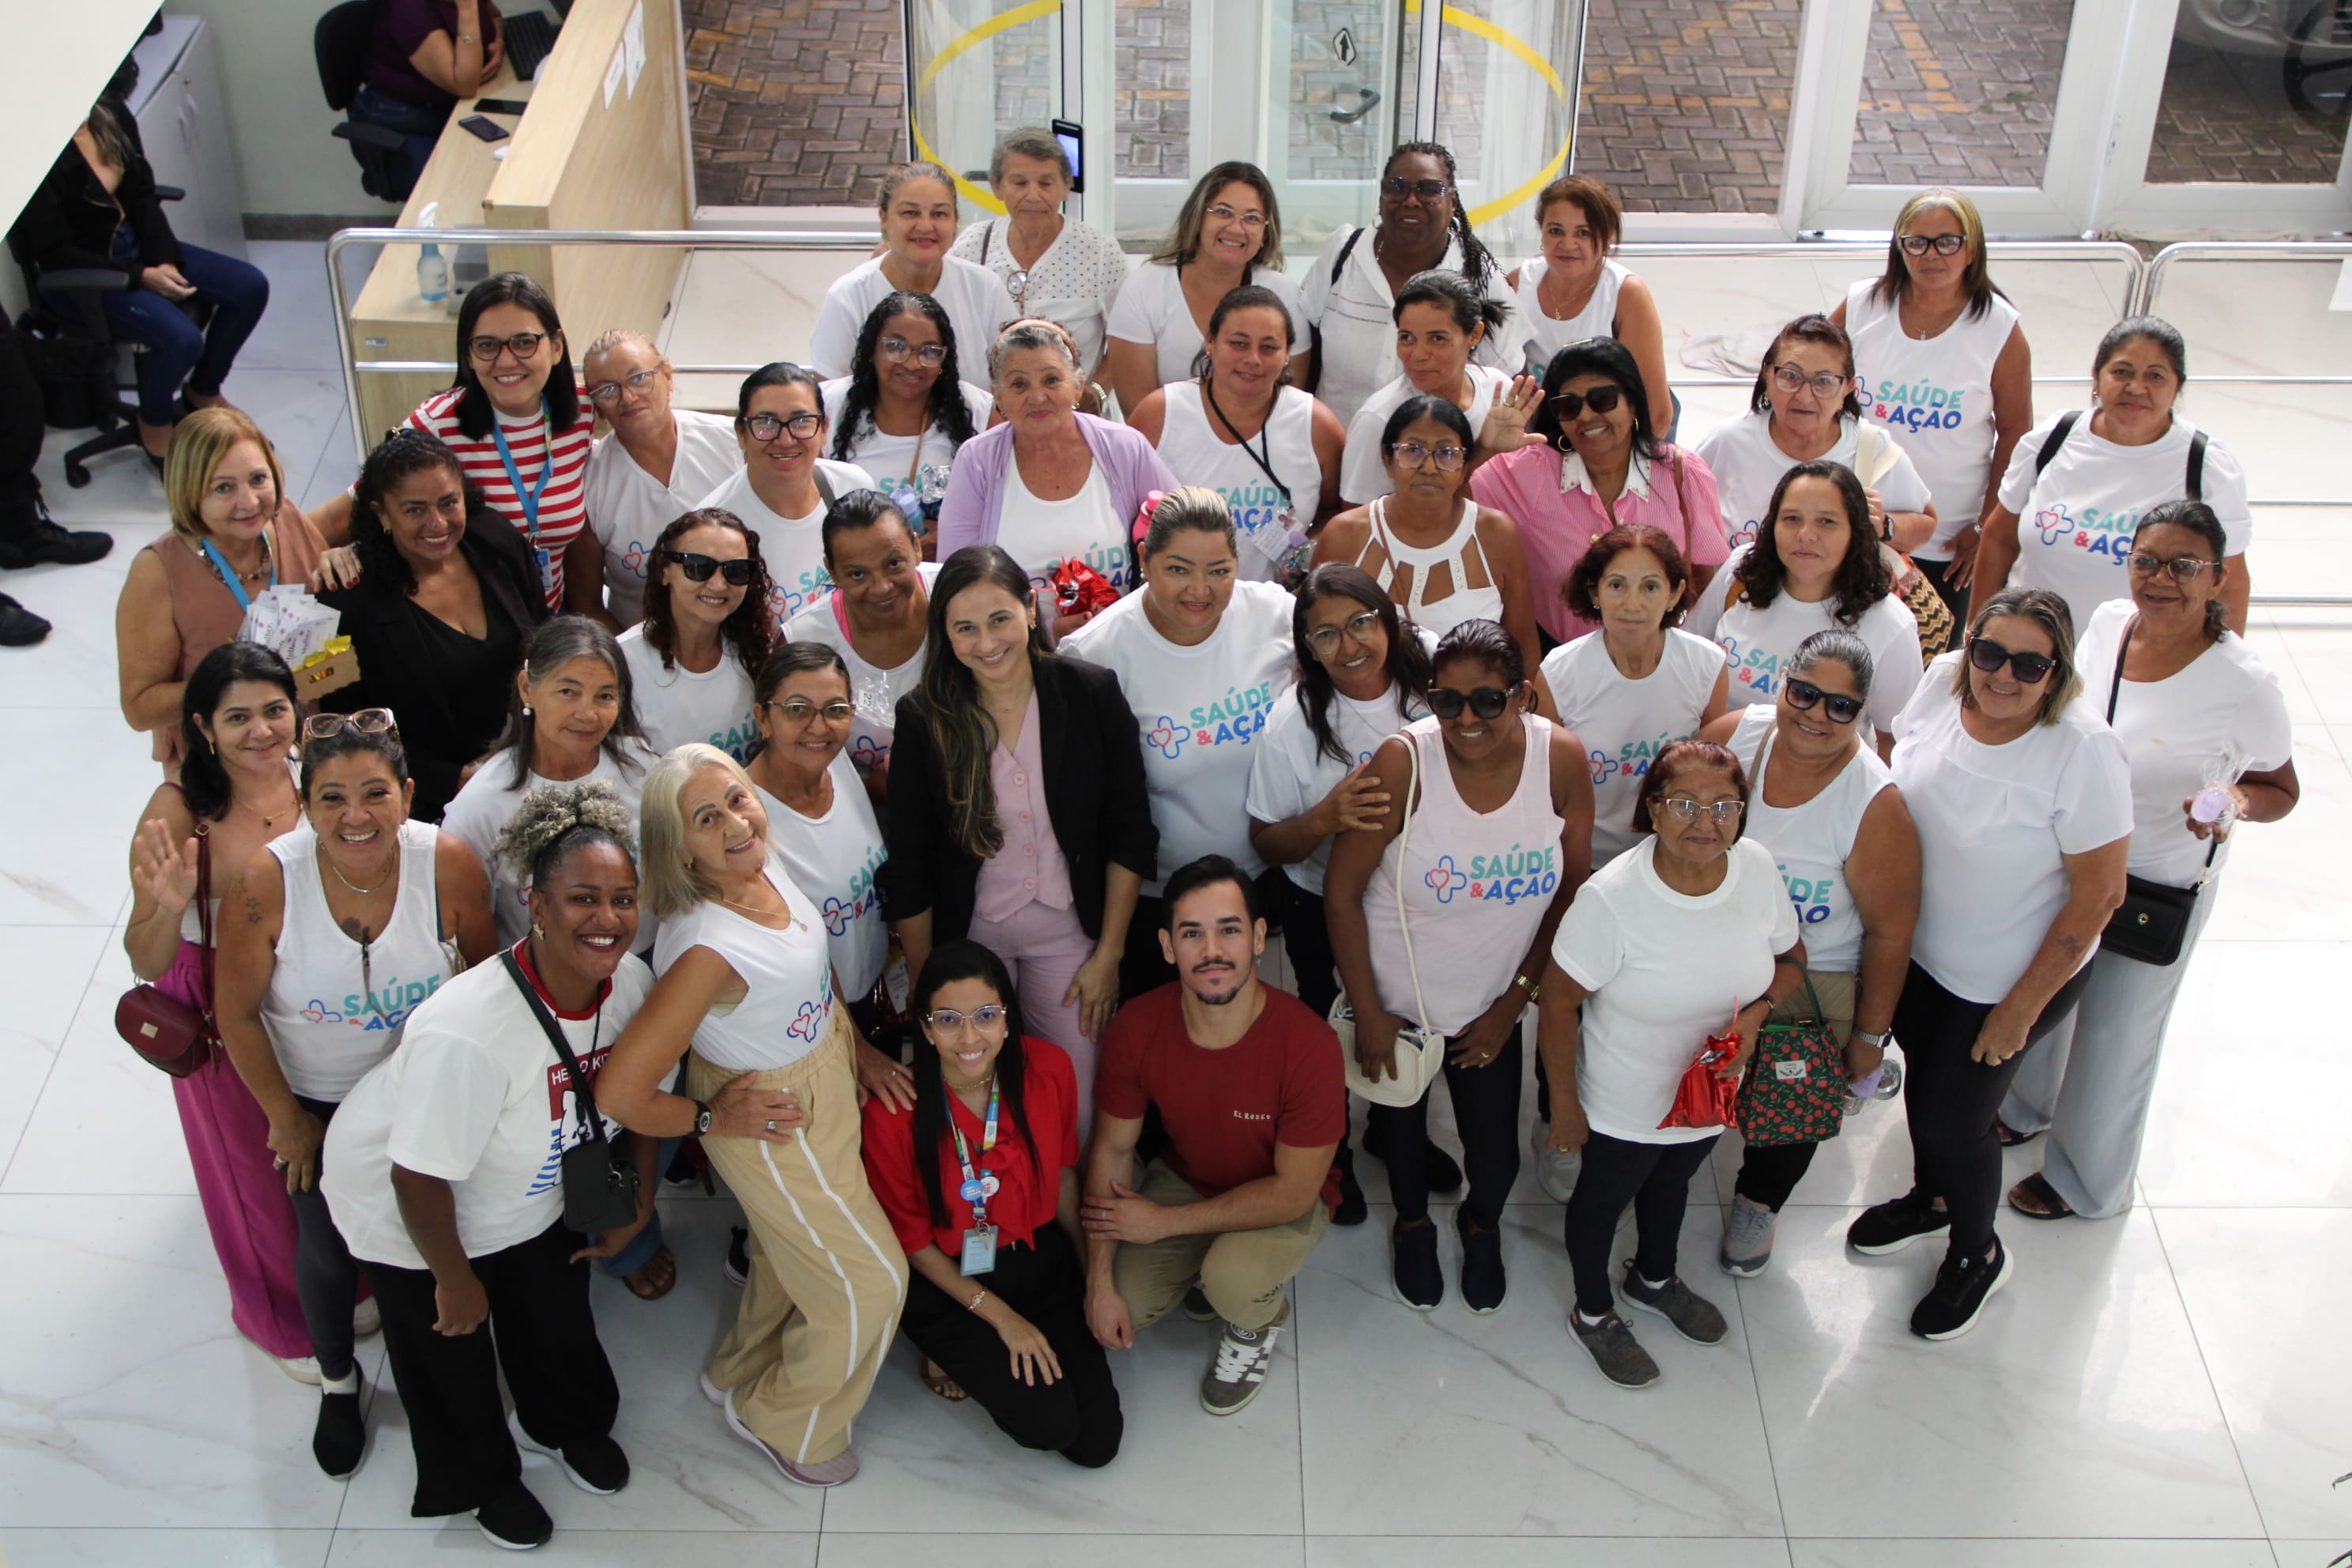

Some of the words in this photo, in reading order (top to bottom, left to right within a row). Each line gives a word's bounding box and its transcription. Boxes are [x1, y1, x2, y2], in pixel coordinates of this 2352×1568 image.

[1875, 378, 1966, 409] SAÚDE
[2079, 507, 2139, 533] SAÚ
[1189, 681, 1271, 729] SAÚDE
[710, 712, 758, 750] SAÚ
[1470, 842, 1554, 880] SAÚDE
[552, 1059, 589, 1085] HEO
